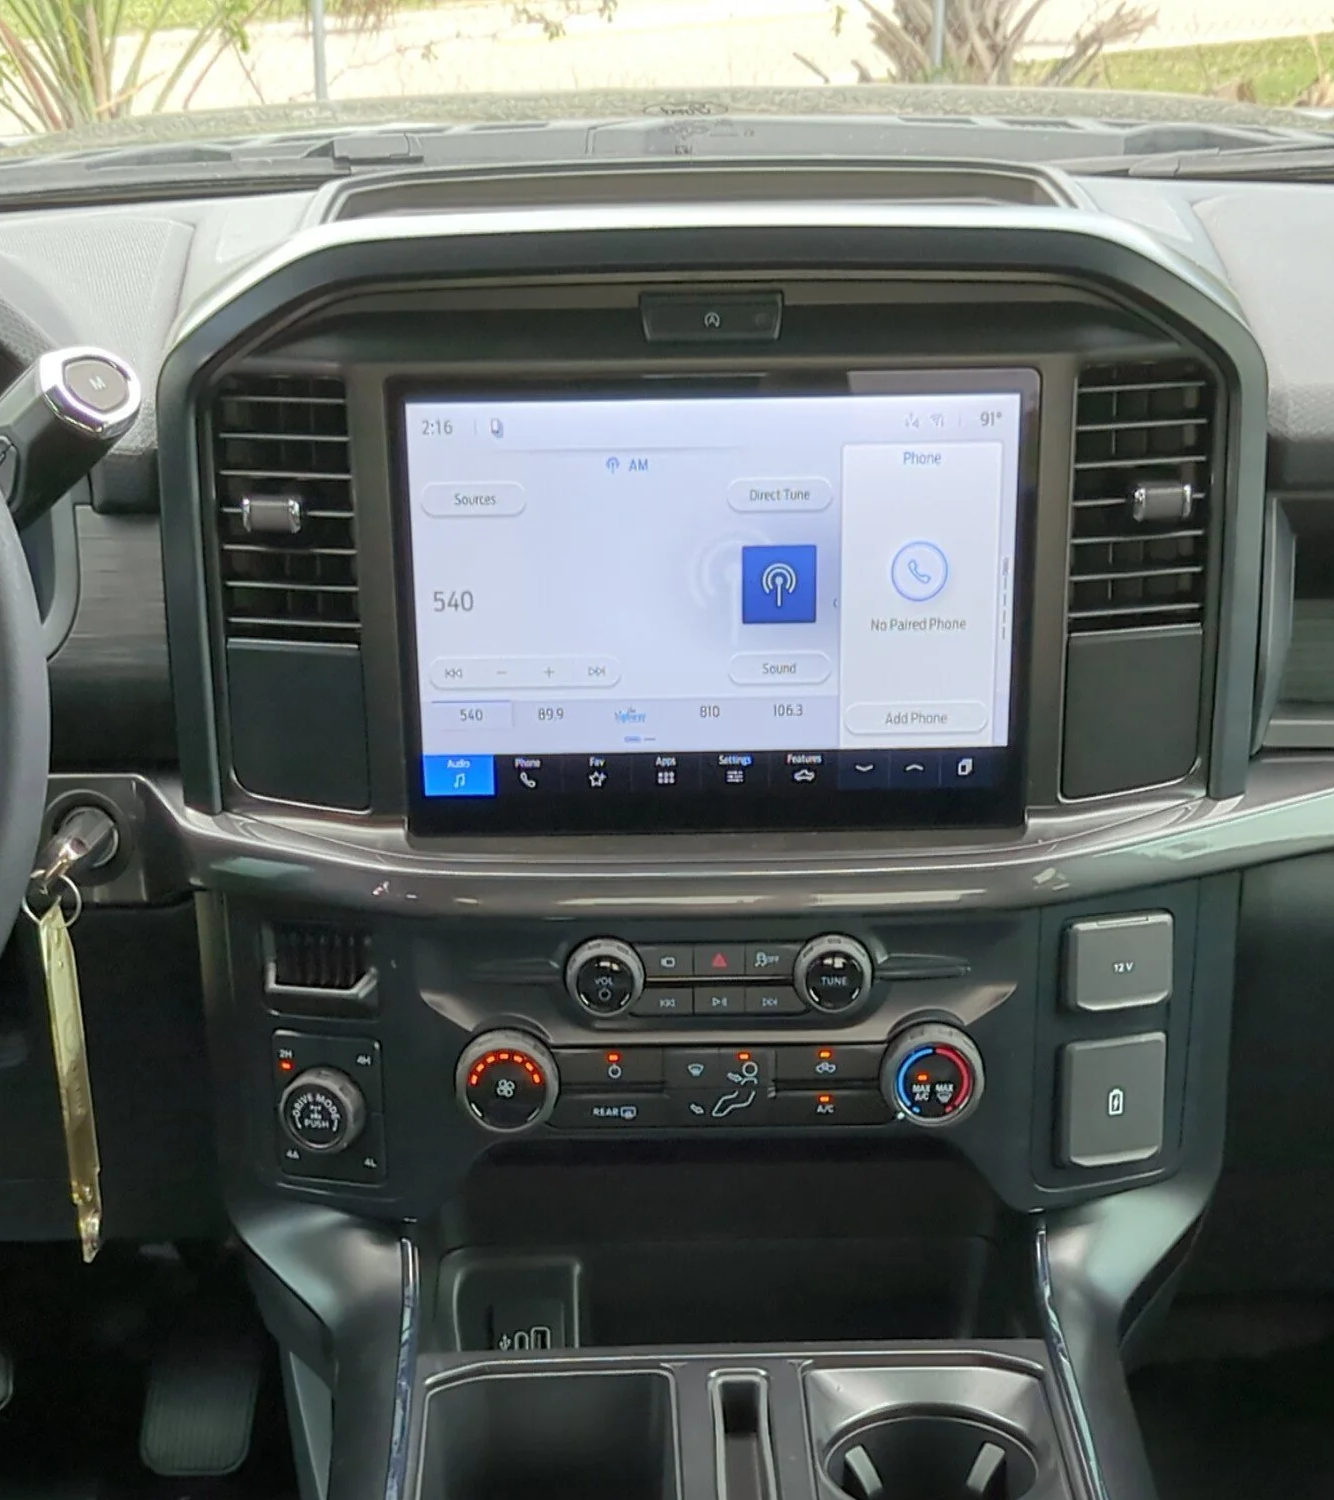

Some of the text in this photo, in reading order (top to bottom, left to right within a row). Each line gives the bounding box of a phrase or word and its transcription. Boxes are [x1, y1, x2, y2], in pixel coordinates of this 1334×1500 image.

[421, 420, 453, 435] 2:16
[903, 451, 942, 464] Phone
[628, 459, 649, 471] AM
[454, 493, 496, 506] Sources
[750, 489, 811, 501] Direct Tune
[432, 590, 474, 612] 540
[870, 617, 967, 631] No Paired Phone
[762, 662, 797, 674] Sound
[459, 708, 483, 721] 540
[538, 707, 564, 720] 89.9
[700, 705, 720, 718] 810
[773, 704, 803, 717] 106.3
[885, 712, 948, 725] Add Phone
[447, 758, 470, 769] Audio
[514, 757, 541, 768] Phone
[589, 756, 605, 767] Fav
[655, 755, 676, 767] Apps
[719, 754, 752, 766] Settings
[787, 753, 822, 764] Features
[1114, 962, 1134, 972] 12 V
[594, 976, 613, 987] VOL
[820, 976, 848, 986] TUNE
[279, 1049, 292, 1059] 2H
[357, 1054, 371, 1065] 4H
[912, 1084, 930, 1093] MAX
[936, 1084, 953, 1093] MAX
[292, 1092, 340, 1121] DRIVE MODE
[593, 1107, 619, 1116] REAR
[817, 1104, 834, 1113] A/C
[304, 1118, 329, 1128] PUSH
